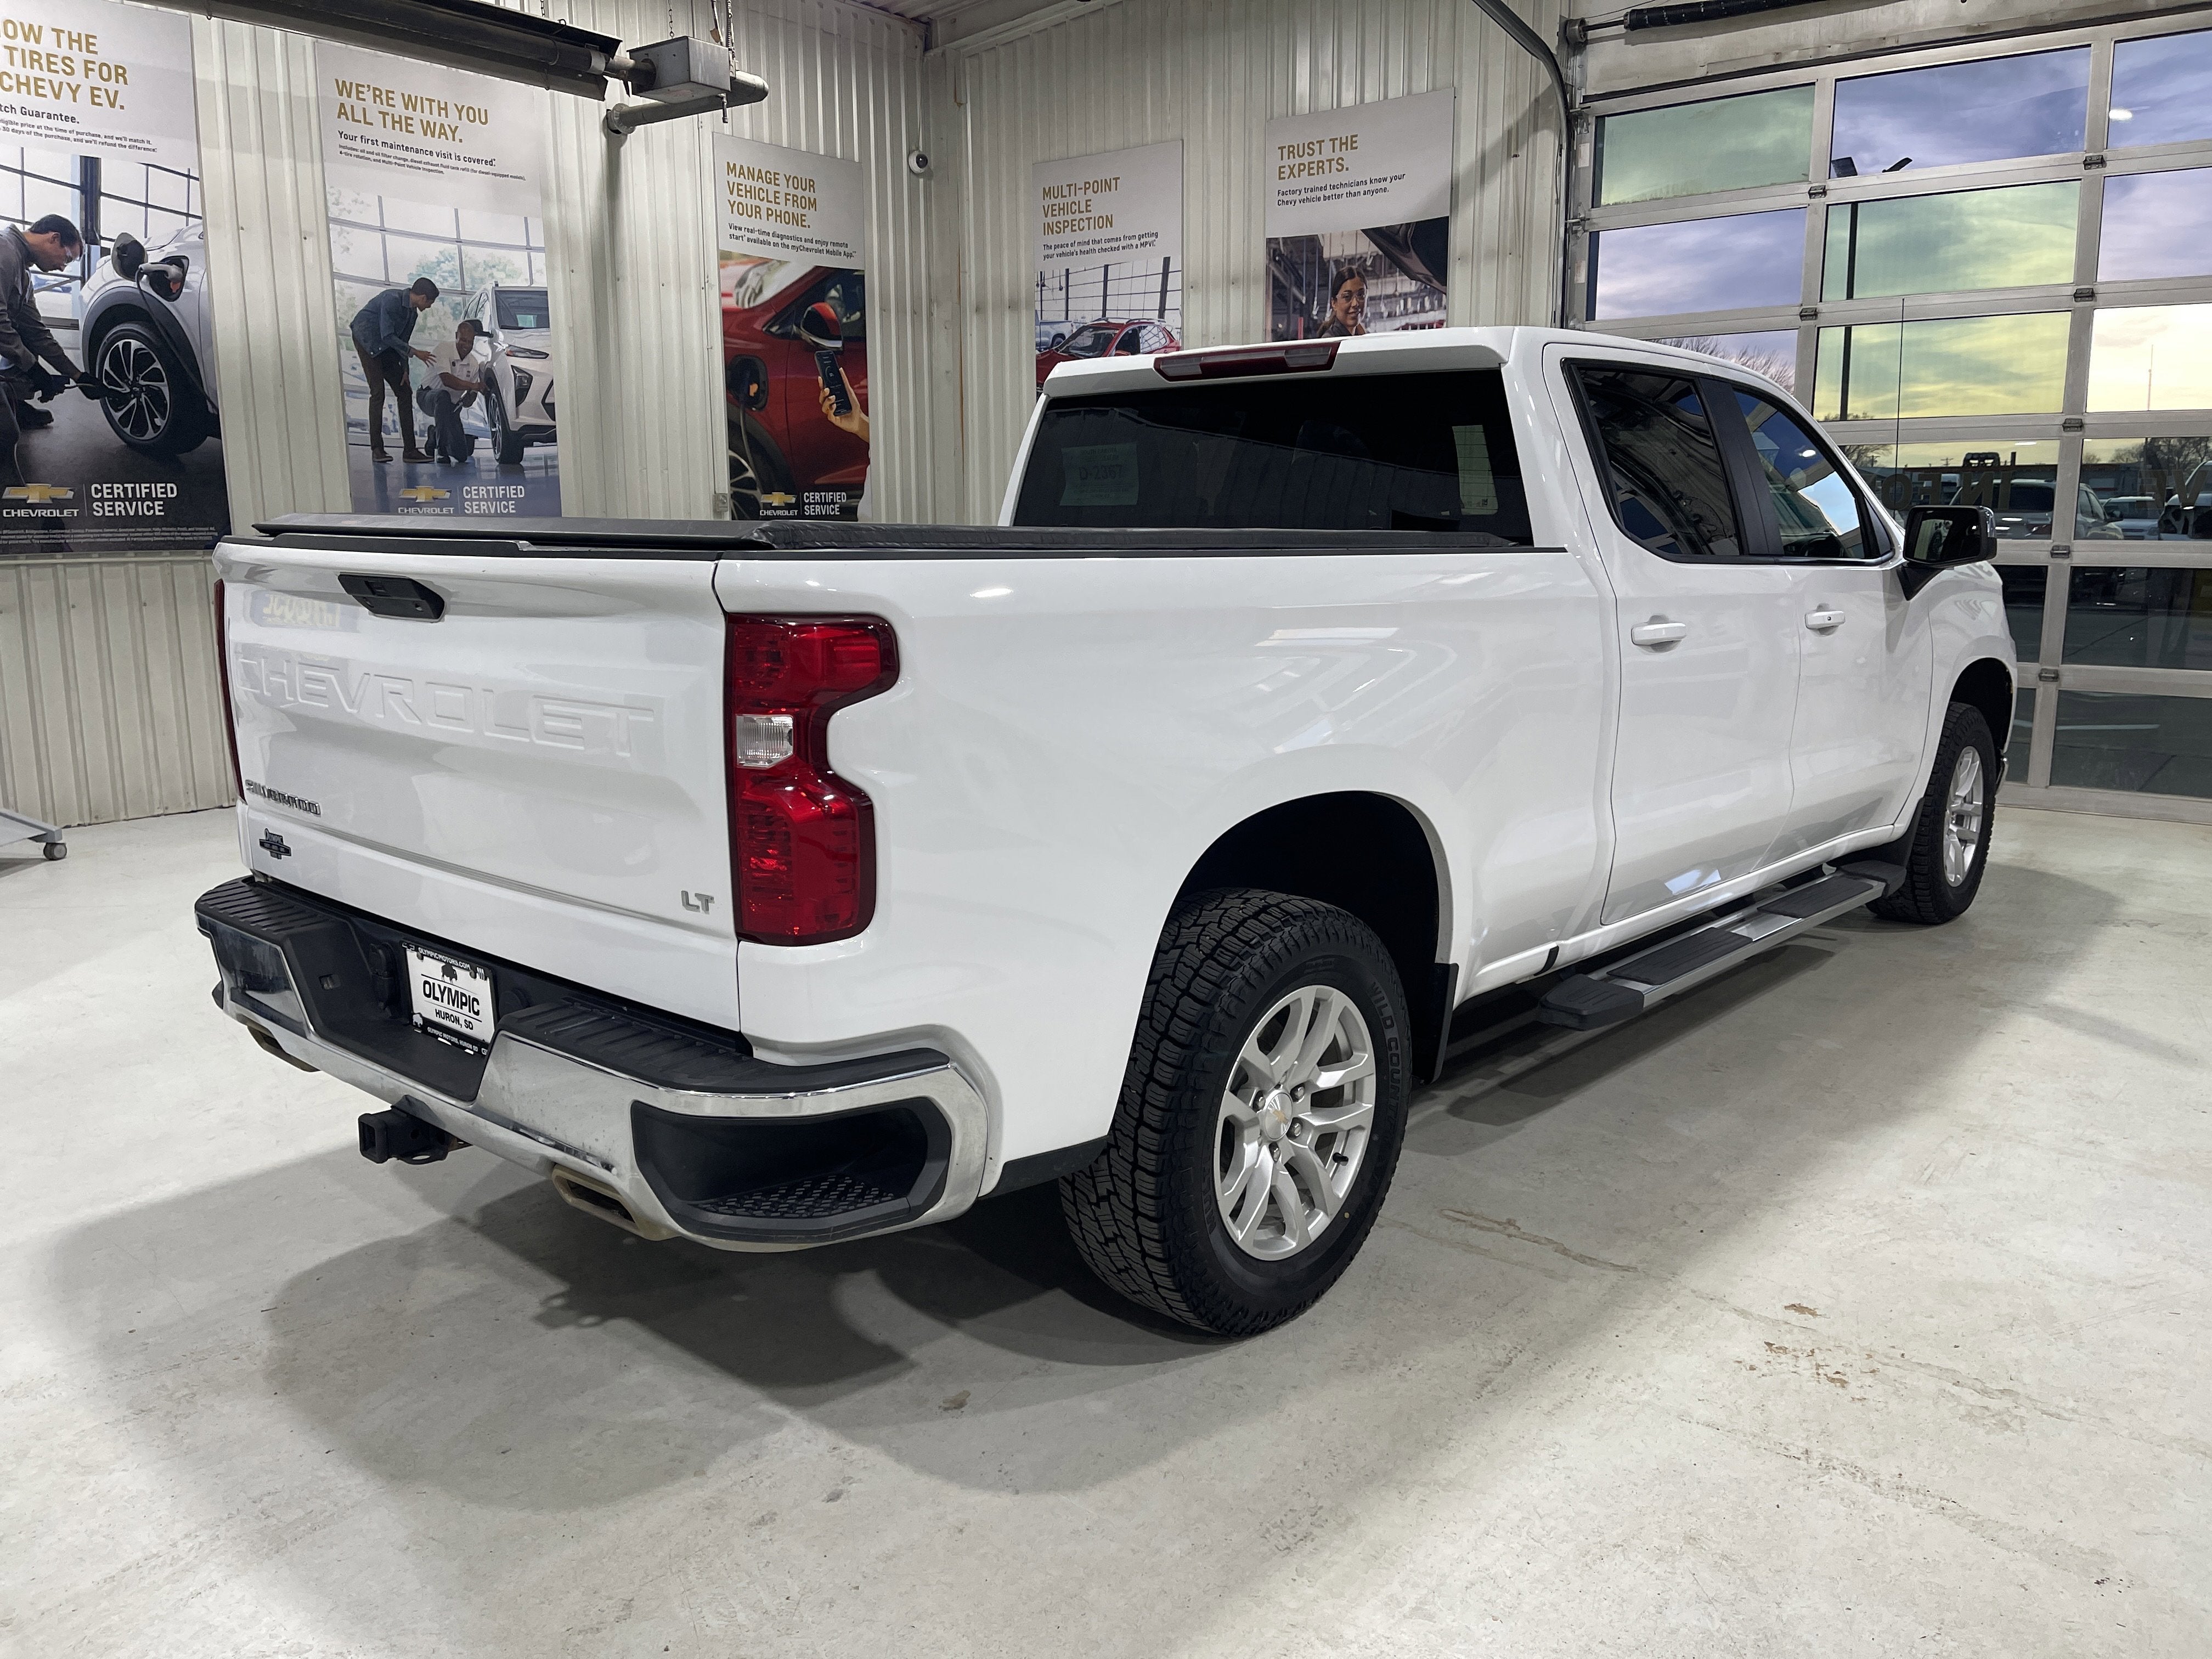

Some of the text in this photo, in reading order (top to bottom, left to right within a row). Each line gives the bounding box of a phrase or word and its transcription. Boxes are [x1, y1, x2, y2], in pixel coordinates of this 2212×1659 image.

[0, 19, 98, 55] OW THE
[3, 45, 128, 85] TIRES FOR
[0, 71, 125, 110] CHEVY EV.
[335, 78, 489, 126] WE'RE WITH YOU
[20, 106, 79, 124] Guarantee.
[337, 103, 462, 143] ALL THE WAY.
[338, 130, 358, 142] Your
[360, 135, 379, 146] first
[381, 141, 433, 156] maintenance
[436, 150, 453, 160] visit
[455, 153, 461, 161] is
[1278, 134, 1358, 161] TRUST THE
[726, 161, 816, 193] MANAGE YOUR
[1278, 157, 1349, 180] EXPERTS.
[727, 180, 817, 212] VEHICLE FROM
[1042, 177, 1120, 201] MULTI-POINT
[1277, 173, 1406, 197] Factory trained technicians know your
[1277, 187, 1390, 207] Chevy vehicle better than anyone.
[727, 199, 810, 228] YOUR PHONE.
[1042, 199, 1092, 218] VEHICLE
[729, 222, 742, 232] View
[744, 227, 770, 237] real-time
[772, 230, 803, 243] diagnostics
[804, 236, 814, 244] and
[815, 239, 829, 248] enjoy
[1043, 214, 1113, 236] INSPECTION
[747, 236, 771, 246] available
[791, 244, 825, 255] myChevrolet
[826, 248, 842, 256] Mobile
[1043, 252, 1054, 261] your
[1056, 248, 1078, 258] vehicle's
[1079, 247, 1096, 256] health
[1098, 244, 1120, 253] checked
[1121, 241, 1134, 250] with
[1053, 242, 1069, 251] peace
[1077, 239, 1090, 247] mind
[1138, 231, 1158, 241] getting
[91, 483, 177, 498] CERTIFIED
[462, 486, 524, 499] CERTIFIED
[804, 492, 847, 503] CERTIFIED
[3, 509, 79, 517] CHEVROLET
[93, 501, 165, 516] SERVICE
[464, 501, 516, 514] SERVICE
[804, 504, 840, 515] SERVICE
[237, 657, 654, 757] CHEVROLET
[245, 779, 321, 817] SILVERADO
[681, 890, 715, 915] LT
[423, 980, 480, 1016] OLYMPIC
[1369, 982, 1395, 1029] WILD
[435, 1008, 473, 1030] HURON, SD
